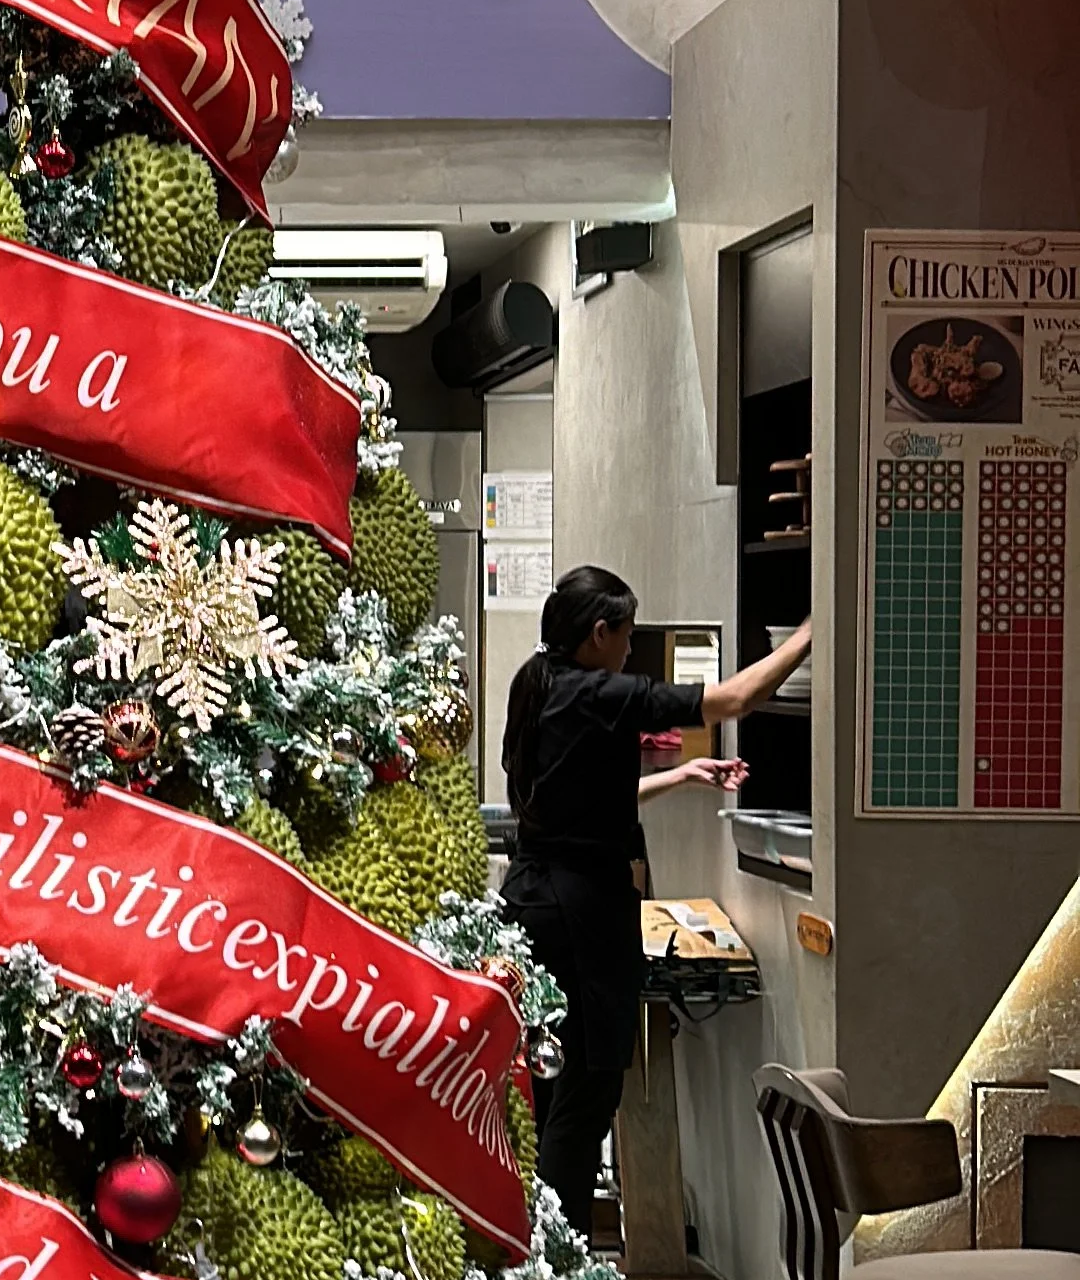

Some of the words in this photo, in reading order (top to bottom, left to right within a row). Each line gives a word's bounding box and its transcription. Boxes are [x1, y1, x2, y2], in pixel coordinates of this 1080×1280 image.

[887, 255, 1019, 300] CHICKEN
[77, 350, 128, 412] a
[985, 446, 1012, 457] HOT
[1015, 446, 1059, 457] HONEY
